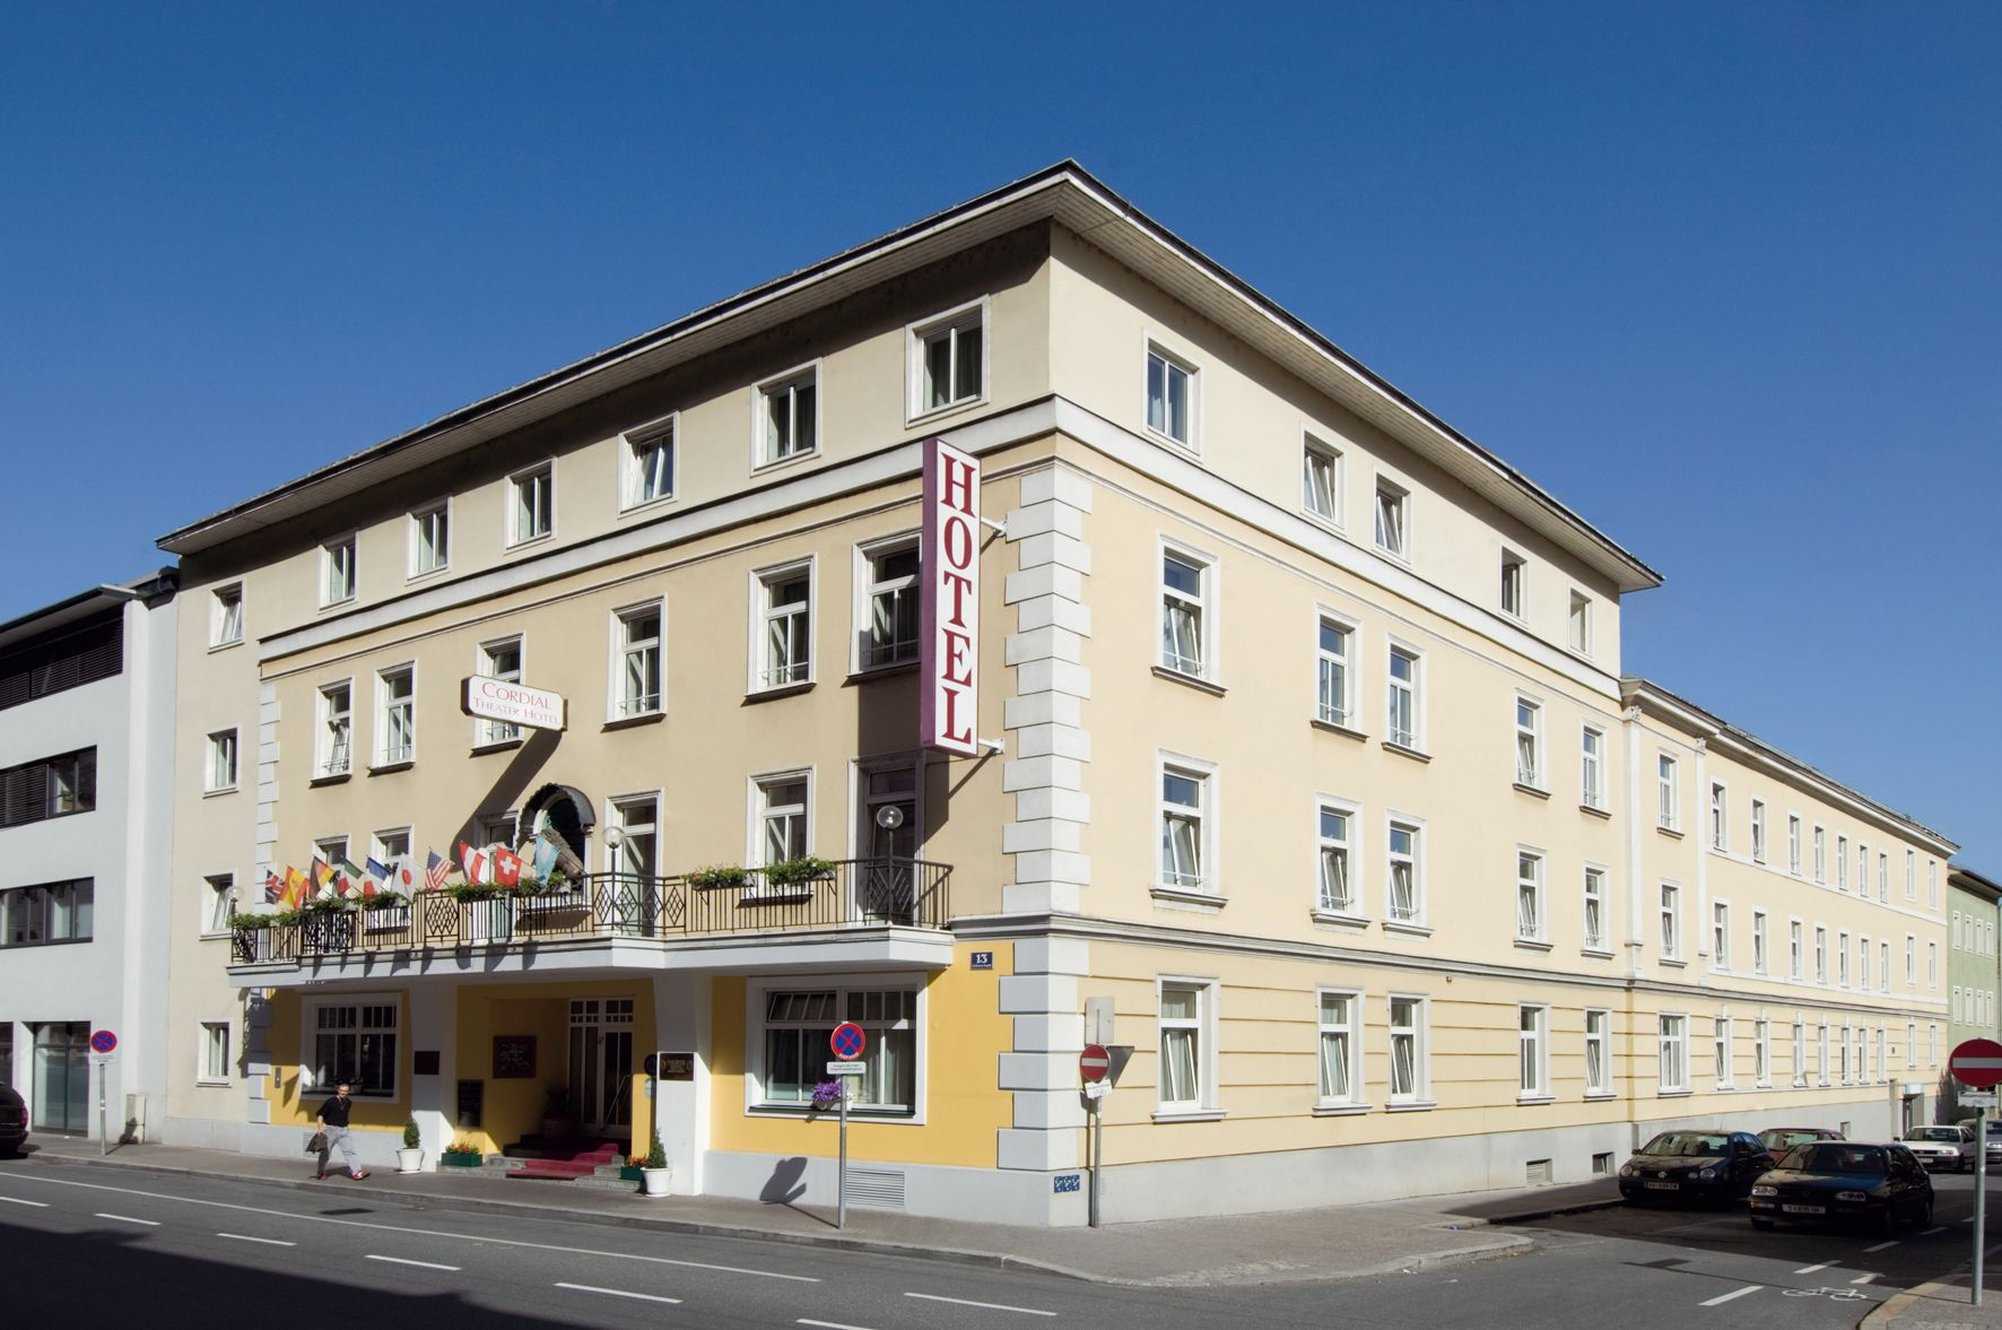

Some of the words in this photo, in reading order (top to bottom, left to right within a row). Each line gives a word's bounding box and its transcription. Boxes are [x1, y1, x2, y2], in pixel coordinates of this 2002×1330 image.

[940, 452, 976, 744] HOTEL
[482, 682, 552, 709] CORDIAL
[976, 953, 988, 964] 13
